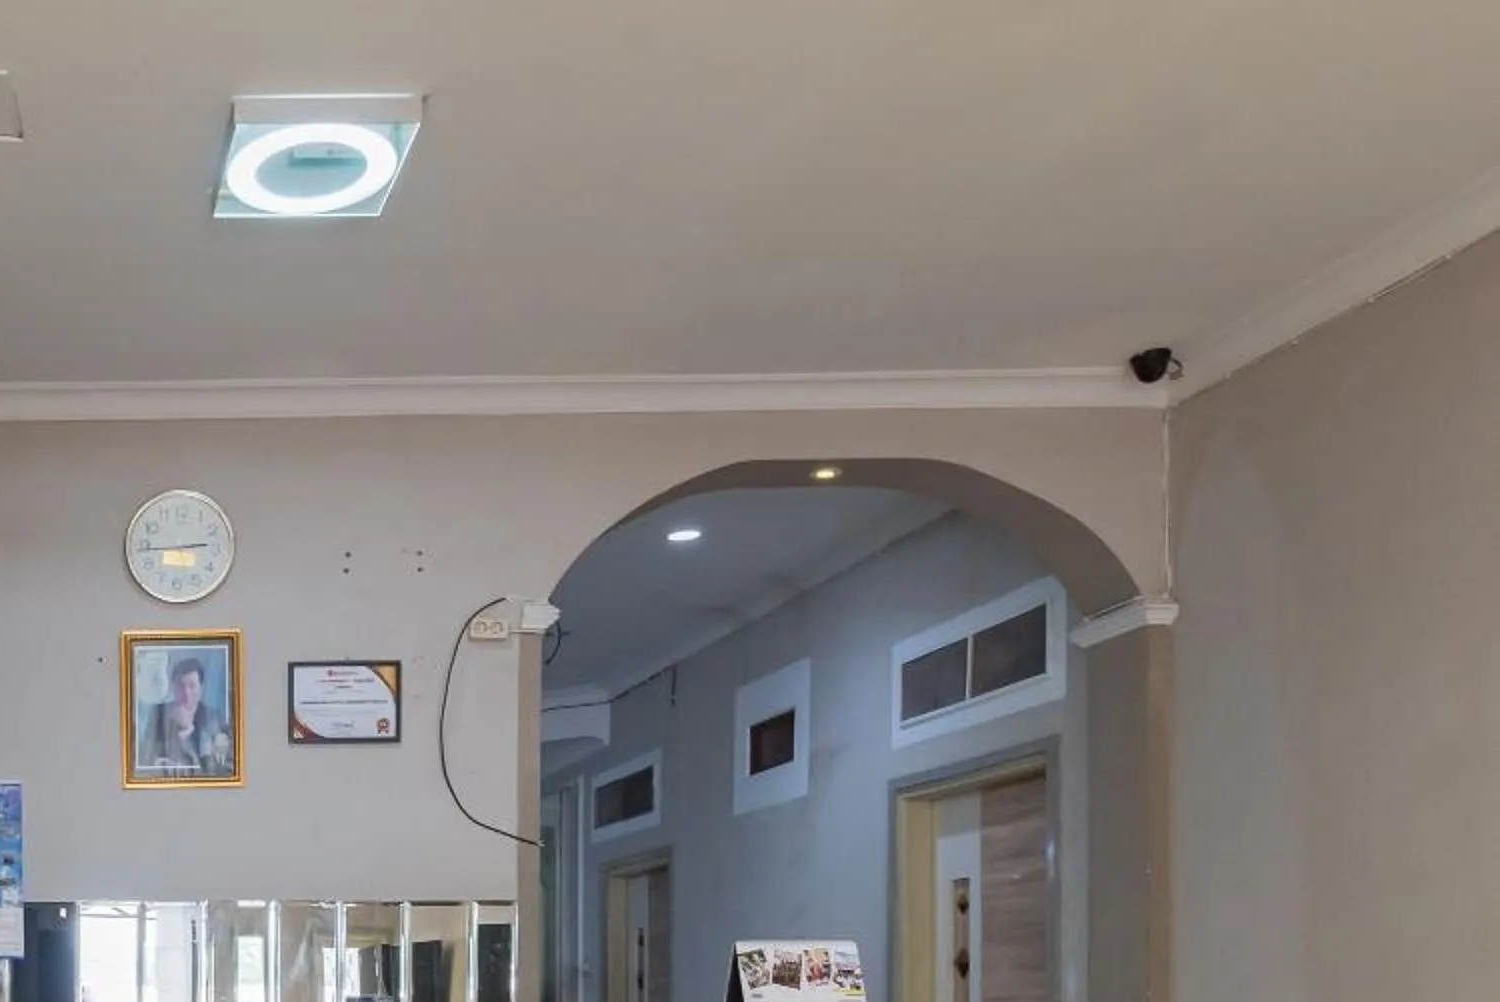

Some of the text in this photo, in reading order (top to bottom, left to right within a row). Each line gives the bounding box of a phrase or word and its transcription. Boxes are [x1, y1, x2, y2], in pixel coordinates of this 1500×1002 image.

[159, 508, 169, 522] 11
[175, 506, 189, 525] 12
[144, 521, 159, 535] 10
[207, 523, 218, 537] 2
[142, 557, 154, 570] 8
[204, 561, 214, 573] 4
[171, 576, 182, 590] 6
[191, 573, 202, 587] 5
